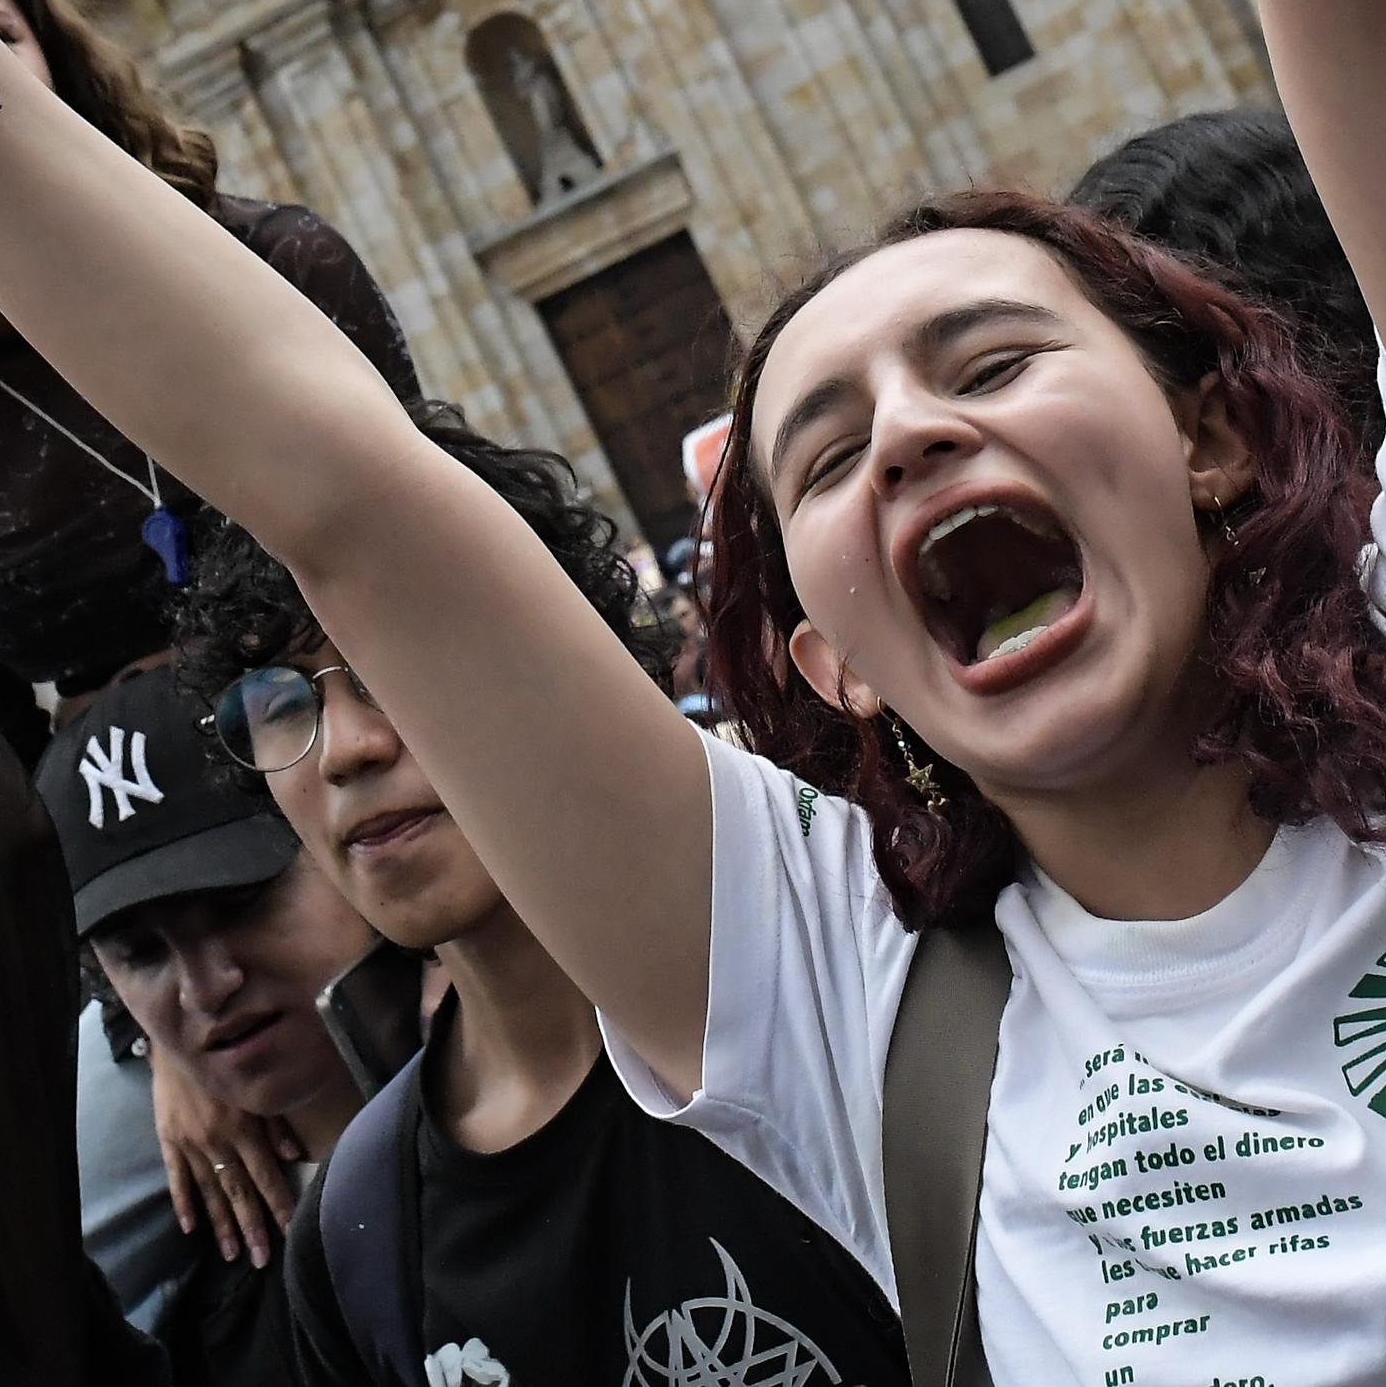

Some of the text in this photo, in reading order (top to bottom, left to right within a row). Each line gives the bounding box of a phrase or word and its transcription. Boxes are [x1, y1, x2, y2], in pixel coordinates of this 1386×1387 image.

[79, 725, 165, 830] NY
[1077, 1102, 1095, 1126] en
[1128, 1073, 1165, 1096] las
[1058, 1132, 1325, 1191] tengan todo el dinero
[1065, 1143, 1082, 1163] y
[1102, 1180, 1226, 1219] necesiten
[1140, 1216, 1239, 1251] fuerzas
[1250, 1194, 1364, 1230] armadas
[1101, 1259, 1136, 1284] les
[1184, 1245, 1257, 1276] hacer
[1269, 1234, 1331, 1255] rifas
[1105, 1291, 1159, 1324] para
[1102, 1314, 1211, 1350] comprar
[1104, 1365, 1135, 1387] un
